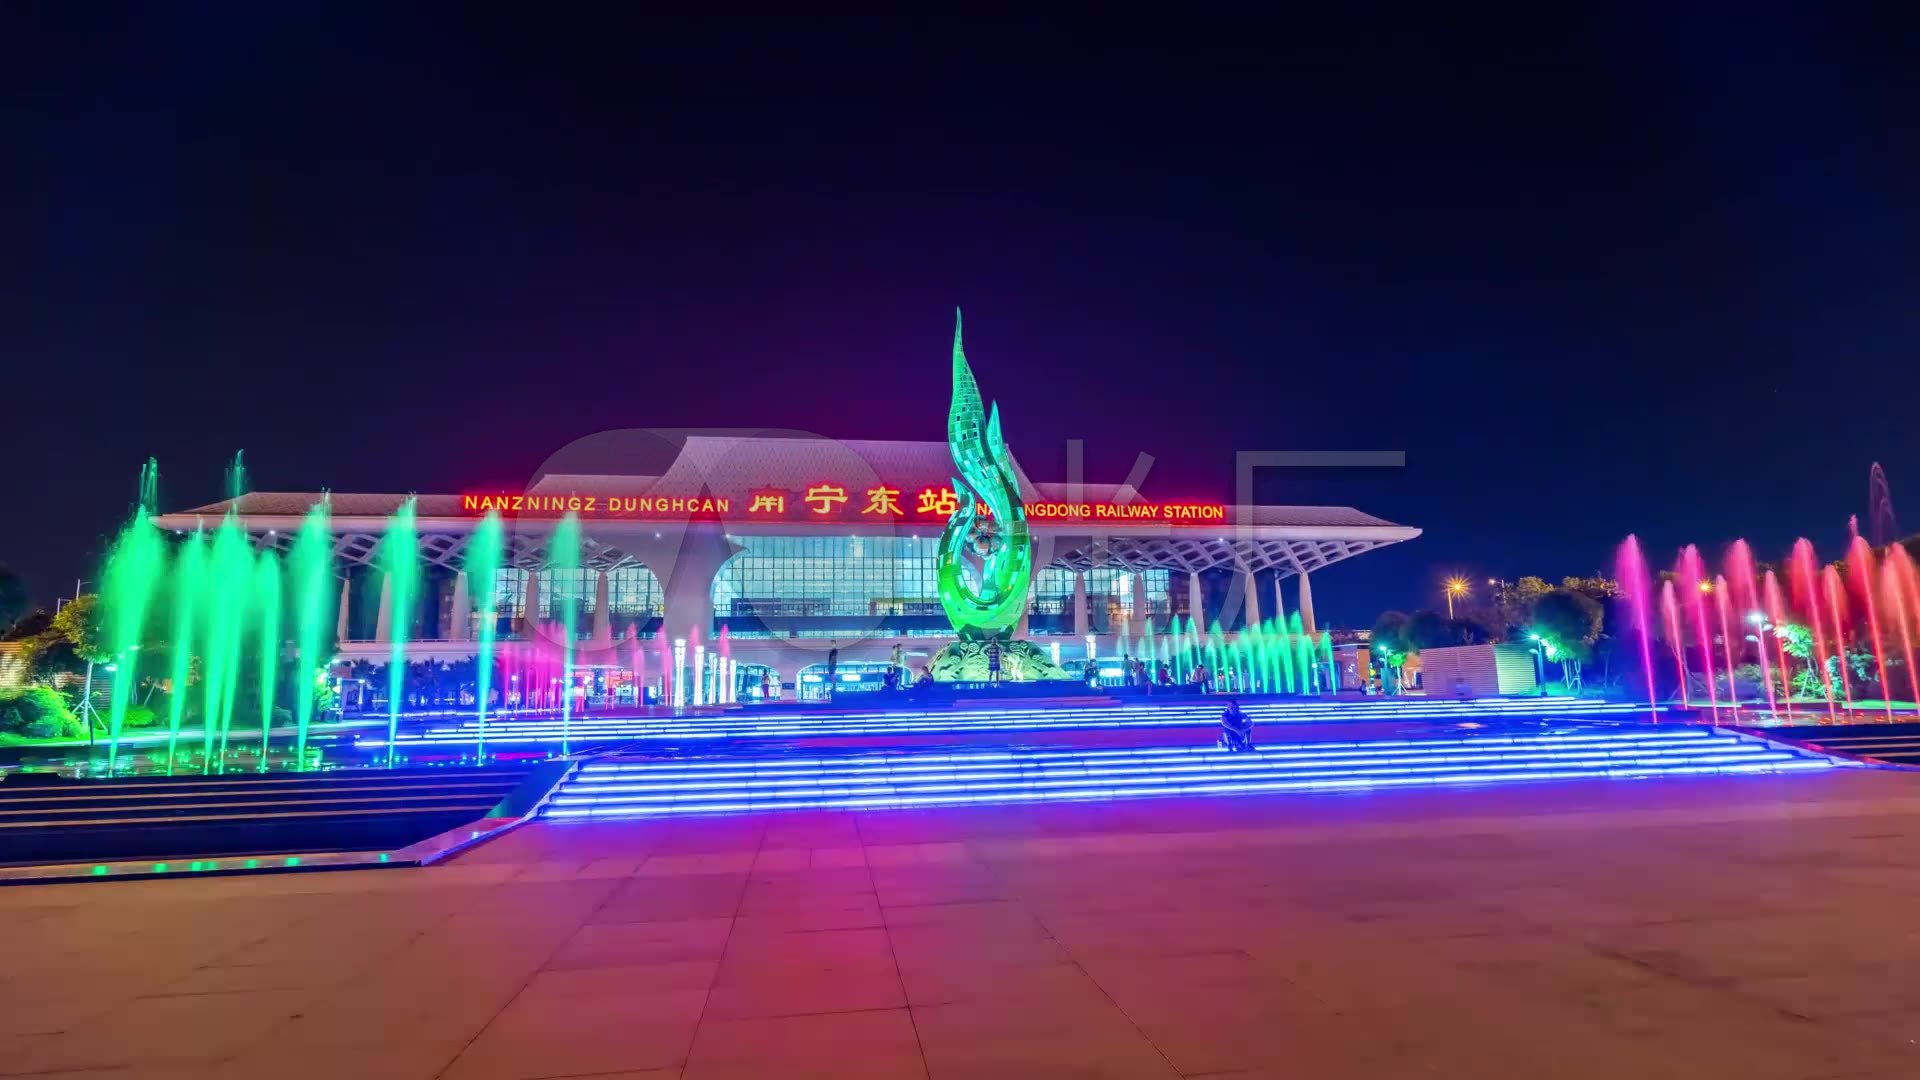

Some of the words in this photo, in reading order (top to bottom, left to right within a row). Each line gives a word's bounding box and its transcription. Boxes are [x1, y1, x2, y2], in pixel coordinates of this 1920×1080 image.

[464, 495, 596, 511] NANZNINGZ
[608, 497, 729, 513] DUNGHCAN
[749, 484, 957, 515] 南宁东站
[977, 503, 1091, 517] NNGDONG
[1096, 504, 1158, 517] RAILWAY
[1163, 504, 1224, 518] STATION
